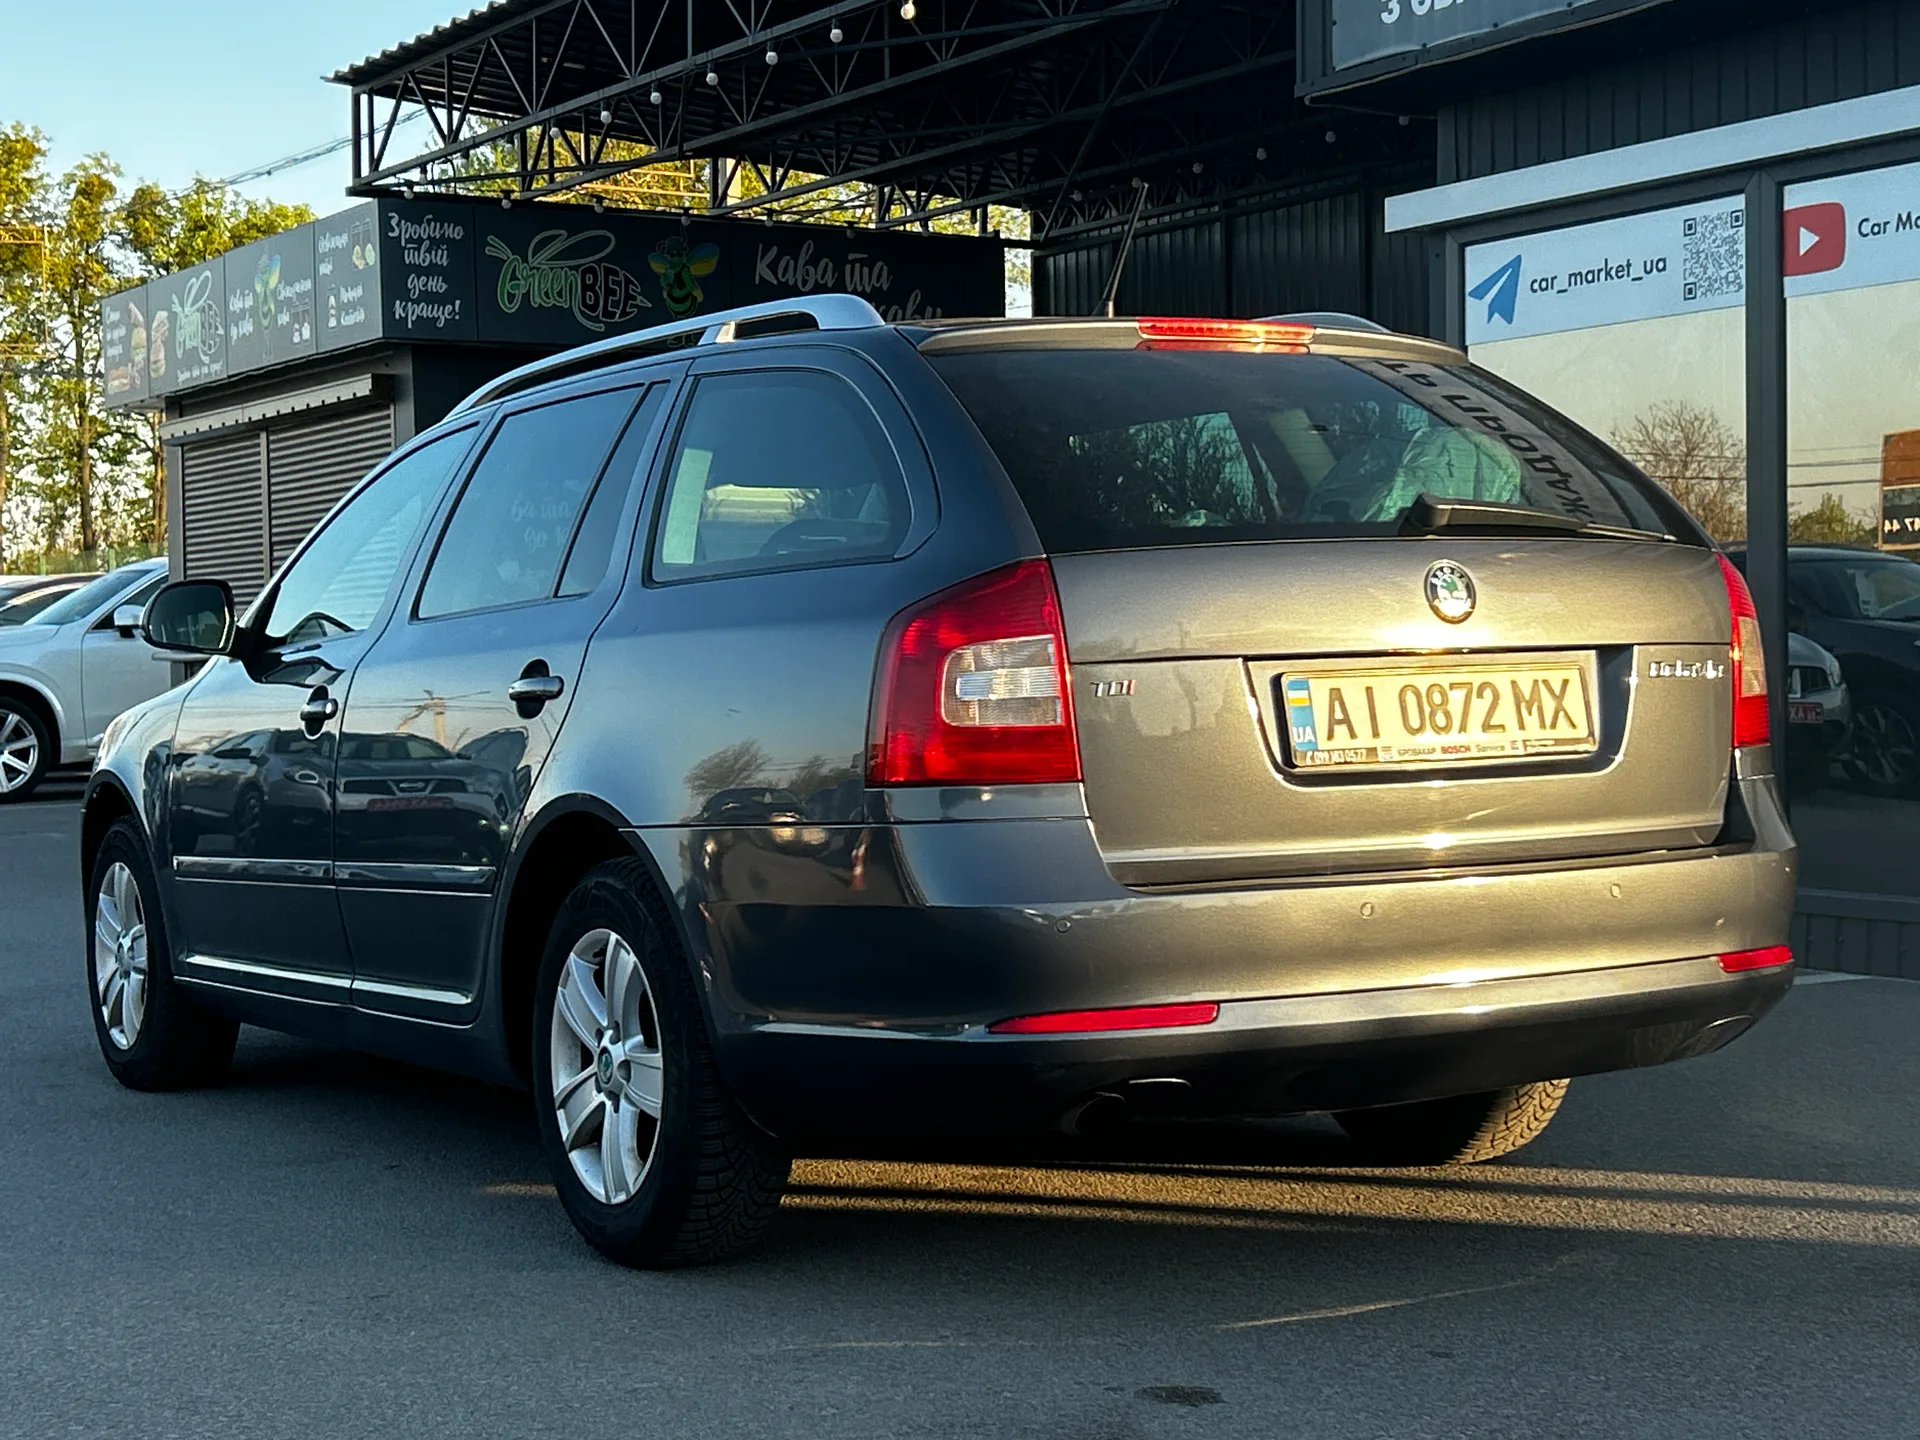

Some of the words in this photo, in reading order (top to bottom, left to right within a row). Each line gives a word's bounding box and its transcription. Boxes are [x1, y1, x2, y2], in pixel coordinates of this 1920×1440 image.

[387, 212, 465, 247] Зробимо
[1857, 217, 1891, 238] Car
[404, 240, 450, 268] твій
[755, 240, 838, 292] Кава
[845, 253, 893, 293] та
[407, 272, 449, 299] день
[1529, 257, 1667, 294] car_market_ua
[392, 299, 461, 329] краще!
[1089, 679, 1137, 697] TDI
[1326, 686, 1381, 741] AI
[1398, 681, 1507, 736] 0872
[1510, 678, 1578, 731] MX
[1292, 726, 1316, 744] UA
[1441, 744, 1472, 755] BOSCH
